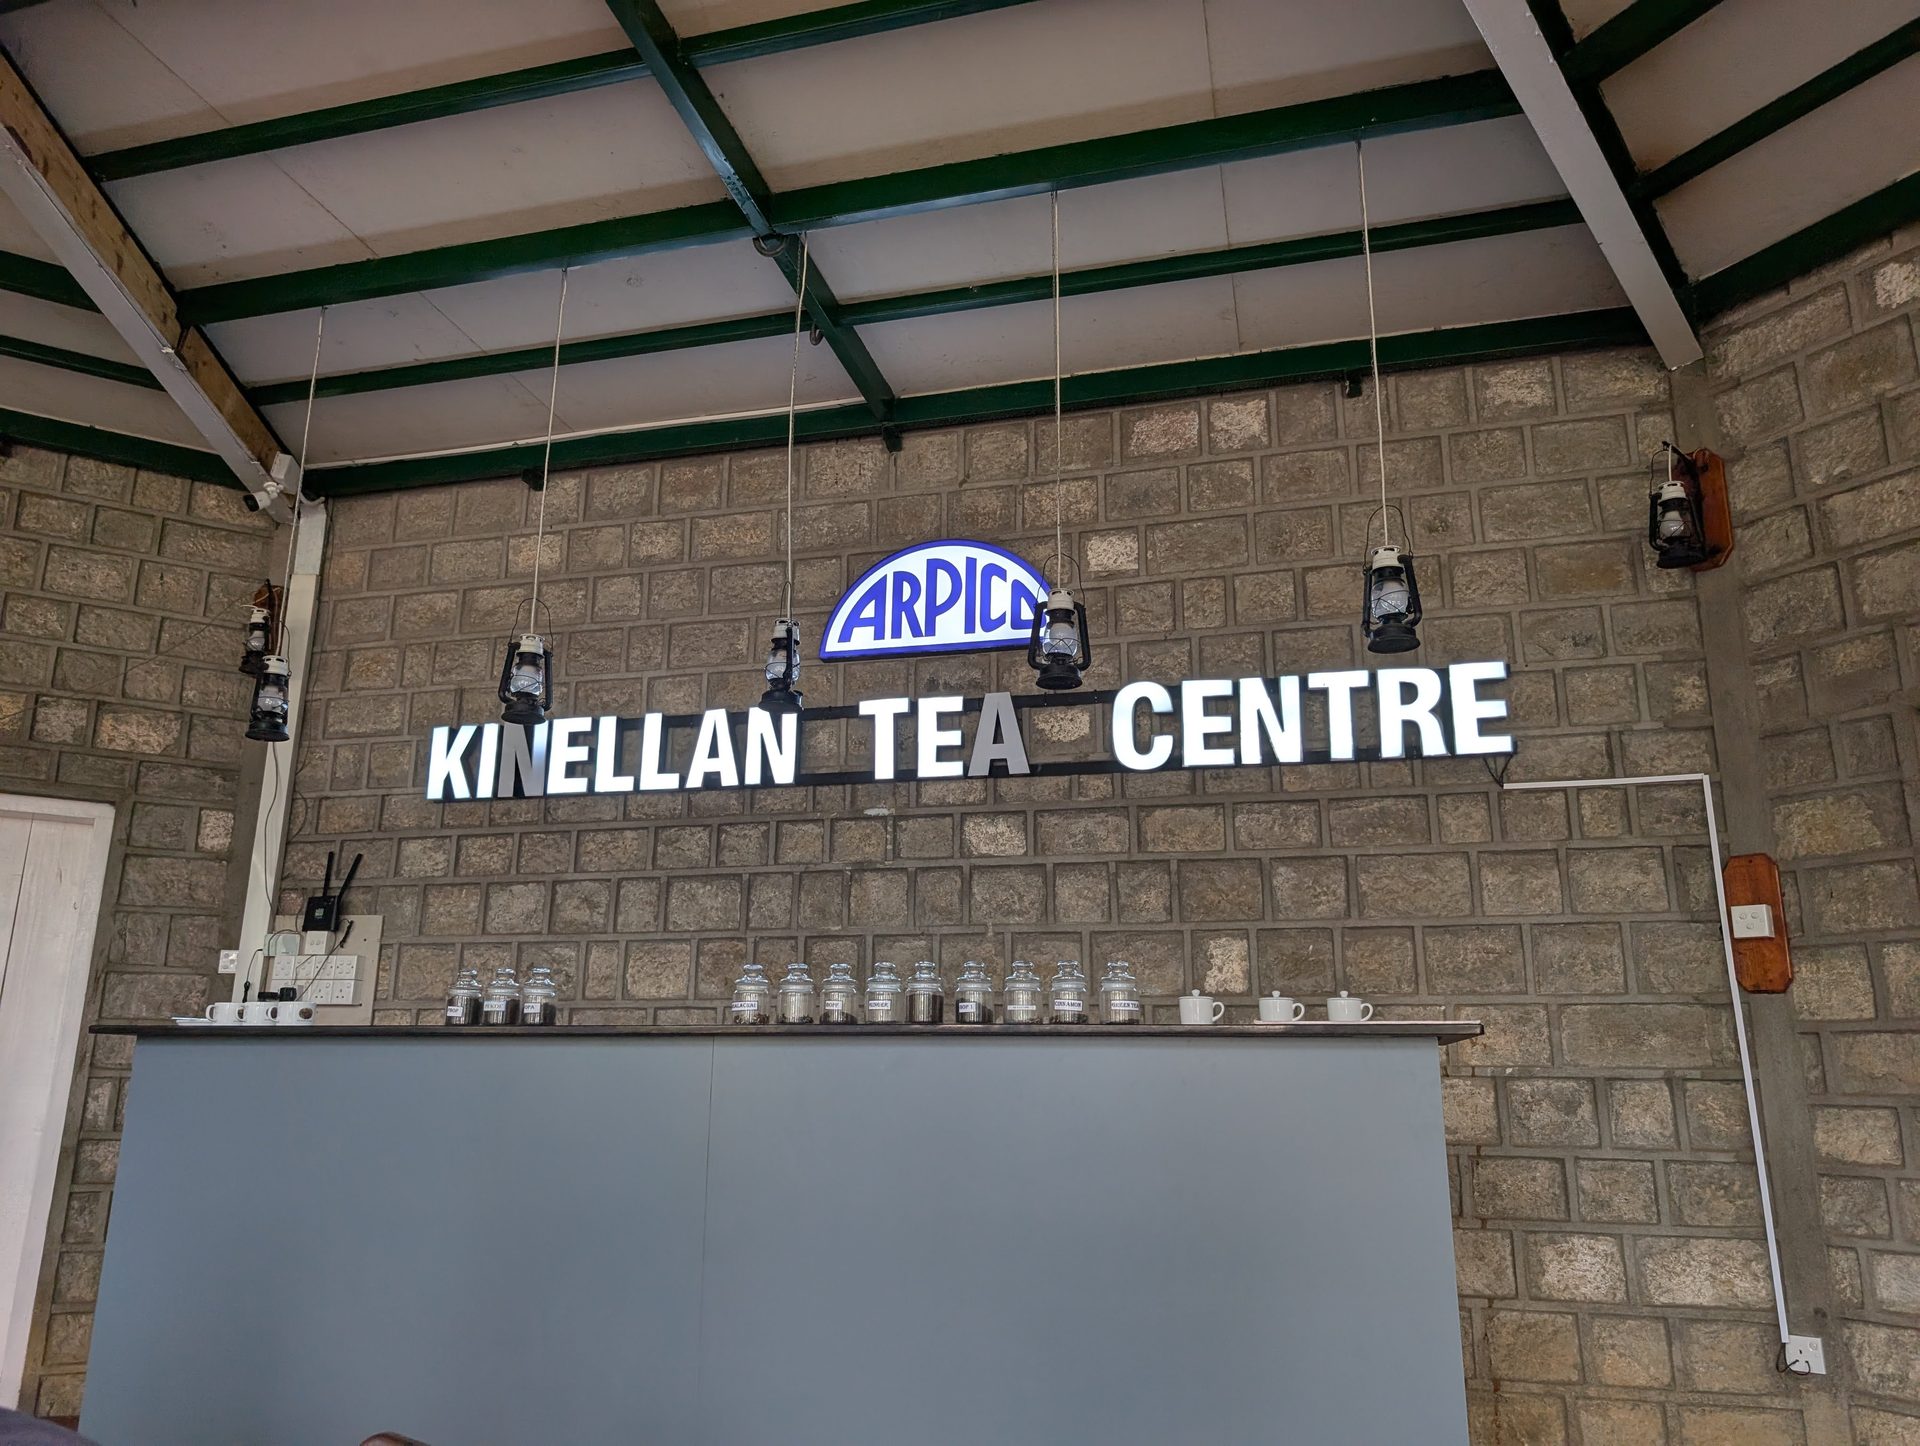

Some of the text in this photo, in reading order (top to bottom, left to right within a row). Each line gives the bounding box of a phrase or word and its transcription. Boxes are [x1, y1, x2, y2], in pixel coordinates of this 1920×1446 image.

[426, 661, 1514, 800] KINELLAN TEA CENTRE
